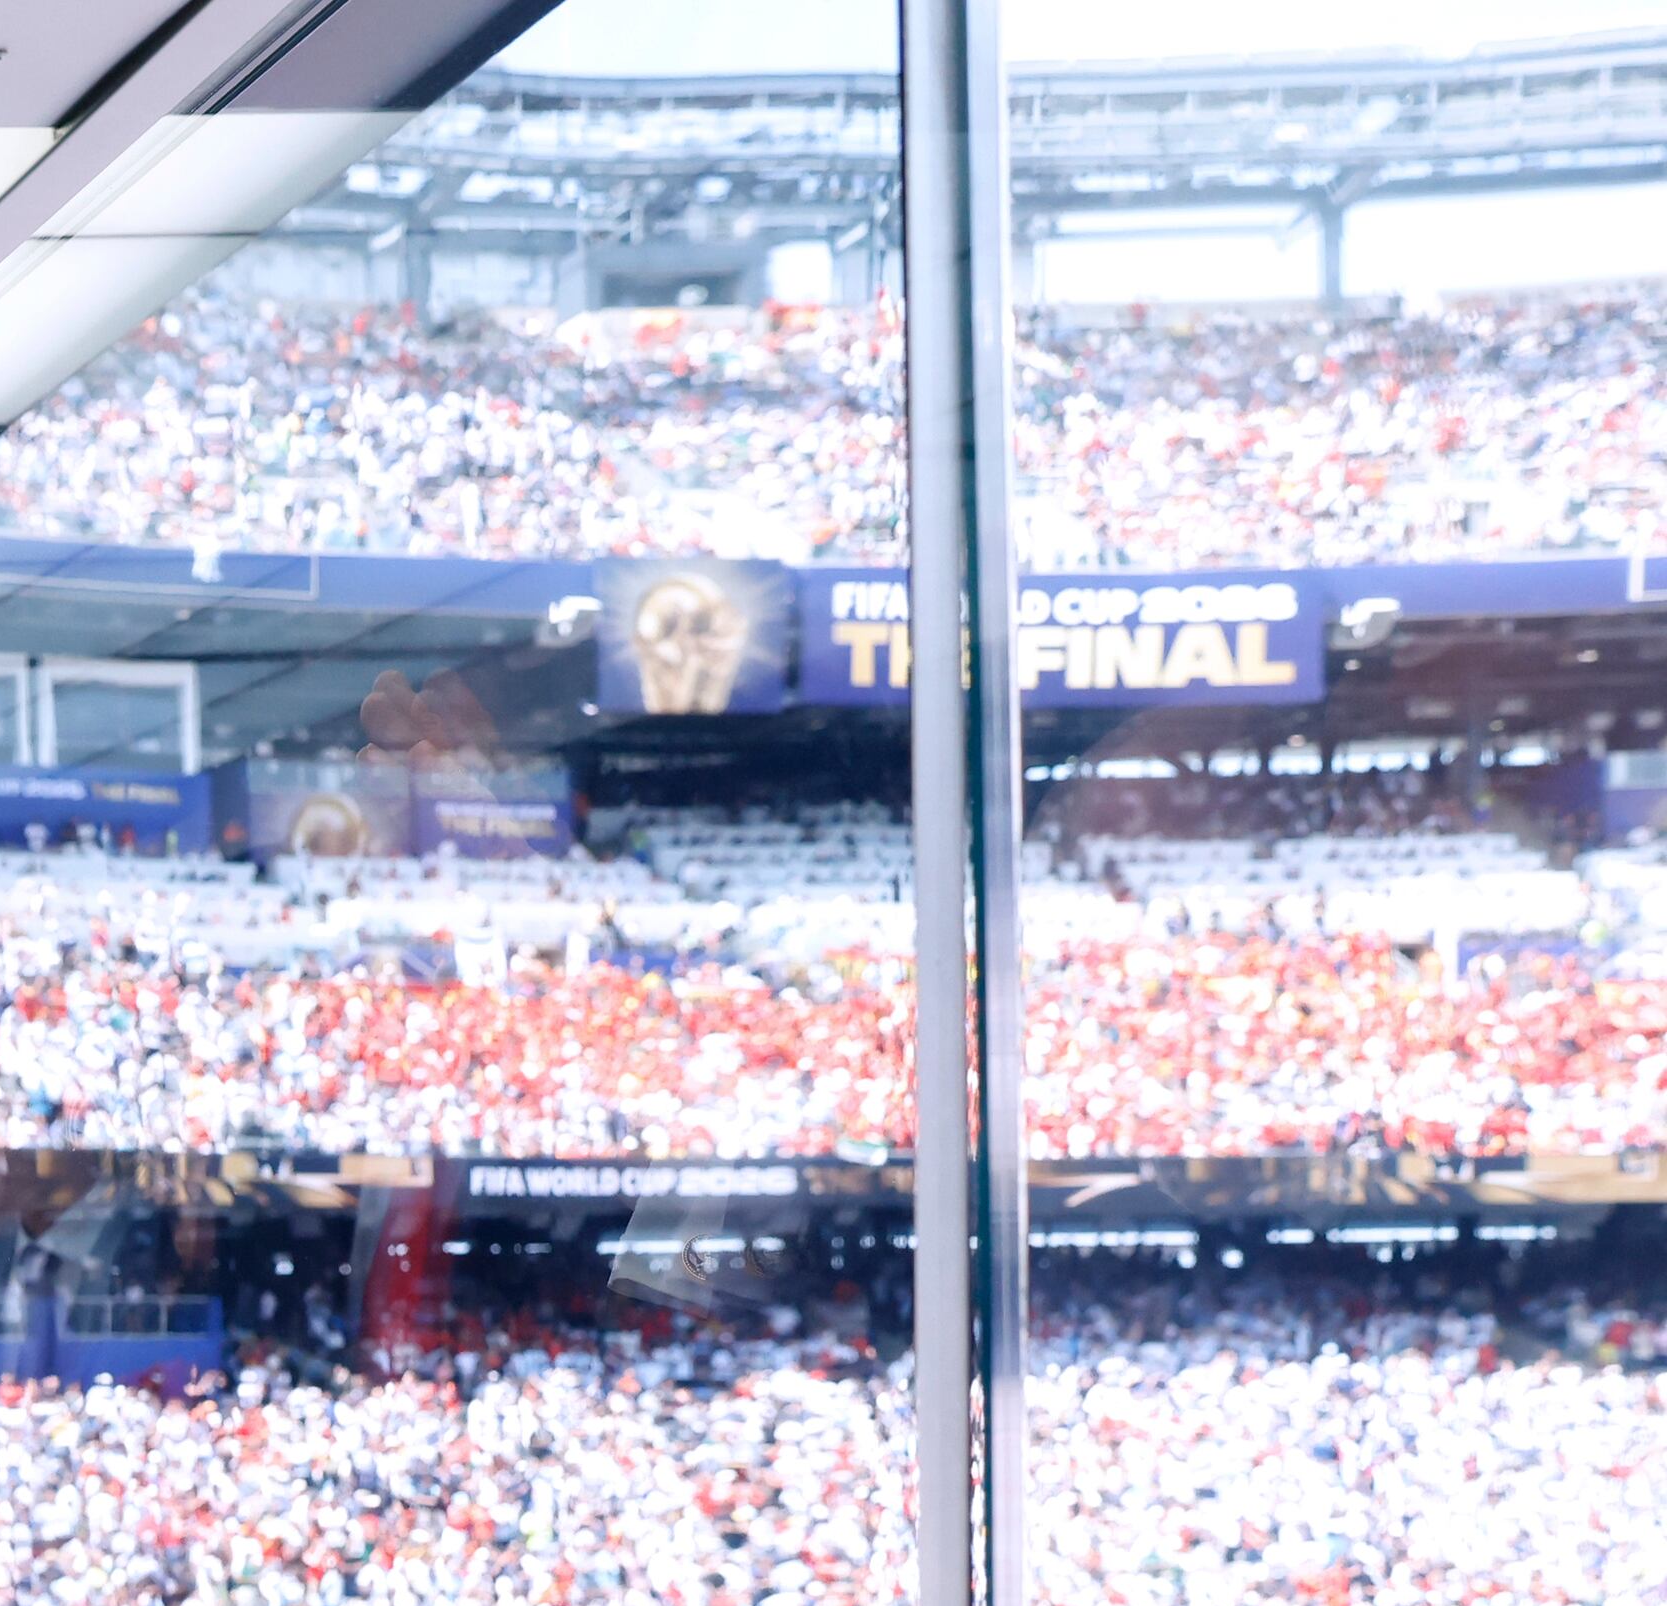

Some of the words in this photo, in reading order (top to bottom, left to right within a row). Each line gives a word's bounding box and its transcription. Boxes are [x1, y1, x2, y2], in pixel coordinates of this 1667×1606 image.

[831, 582, 909, 621] FIFA
[1053, 588, 1139, 626] CUP
[1017, 622, 1297, 690] FINAL
[470, 1166, 527, 1197] FIFA
[527, 1166, 620, 1197] WORLD
[620, 1166, 678, 1197] CUP
